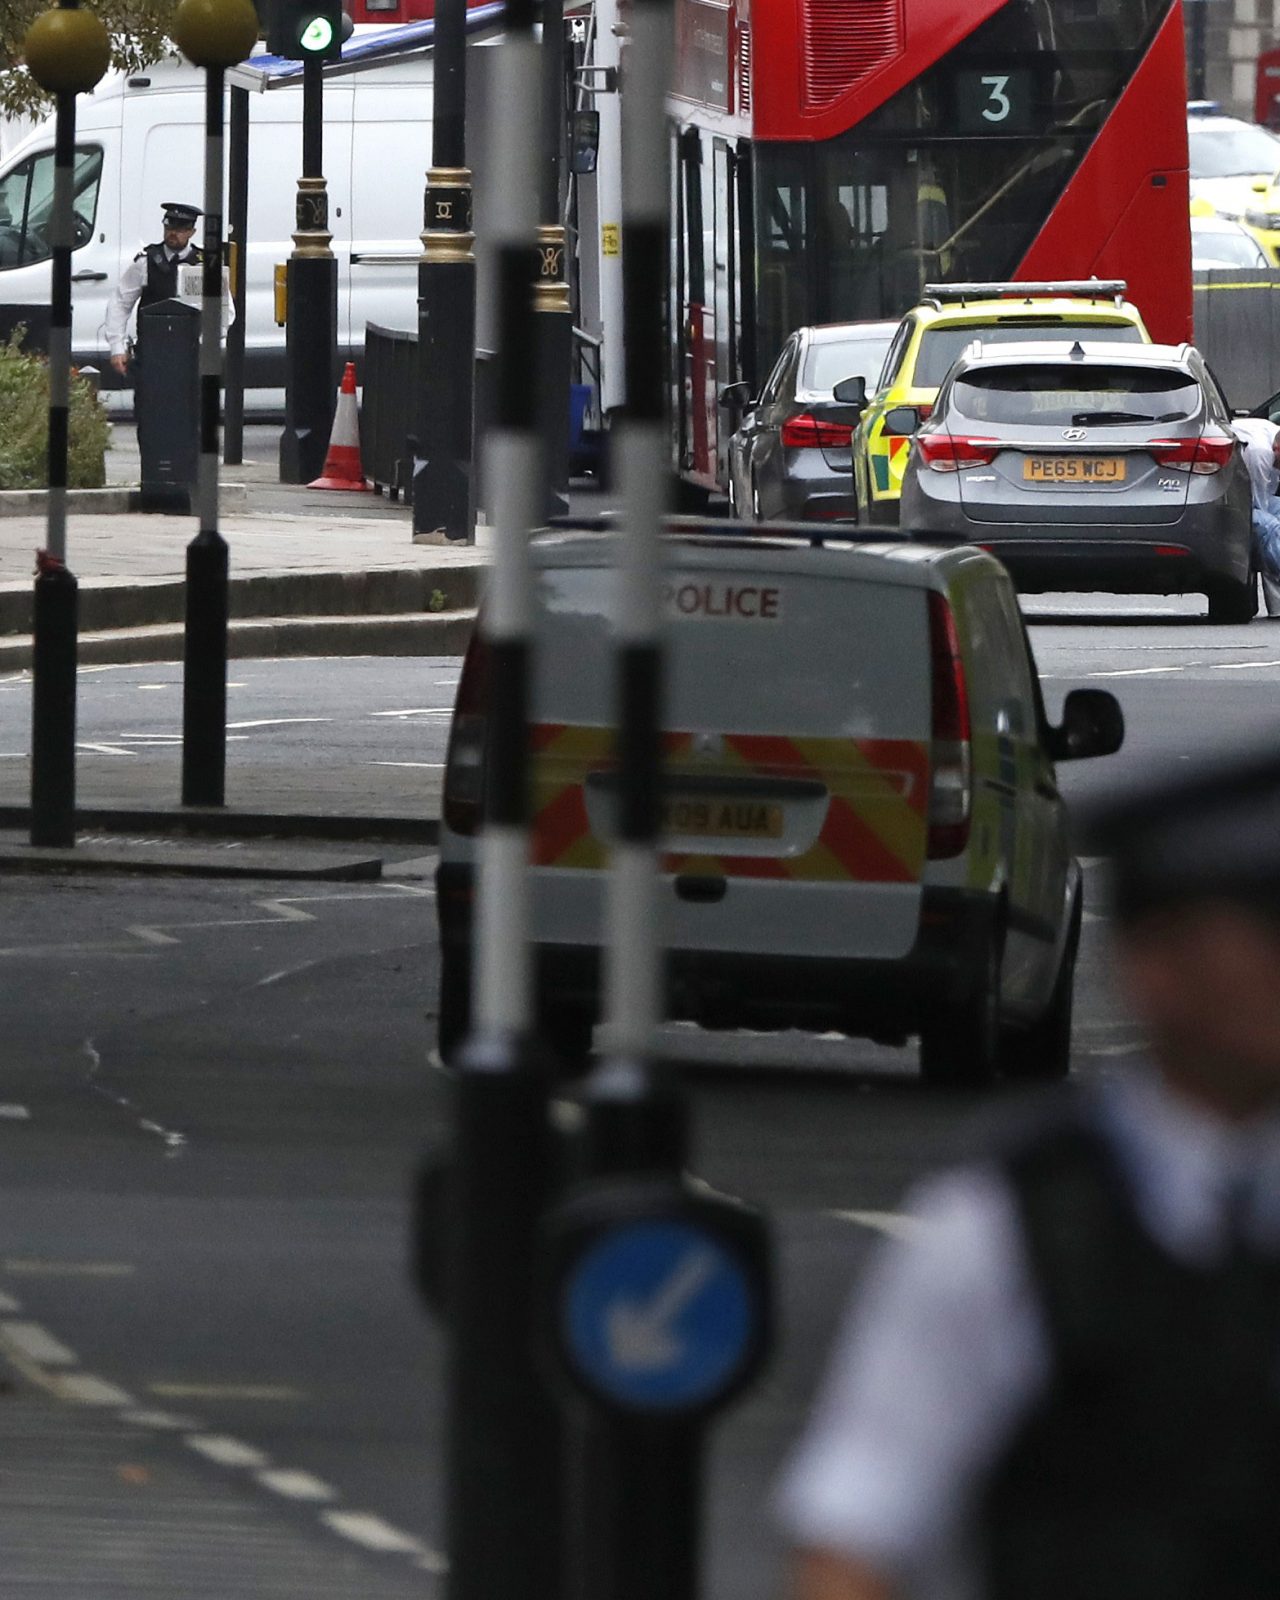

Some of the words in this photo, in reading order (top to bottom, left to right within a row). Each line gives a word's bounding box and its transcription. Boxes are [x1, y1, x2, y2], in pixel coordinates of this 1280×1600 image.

[981, 76, 1010, 122] 3
[1031, 460, 1077, 476] PE65
[1083, 460, 1117, 476] WCJ
